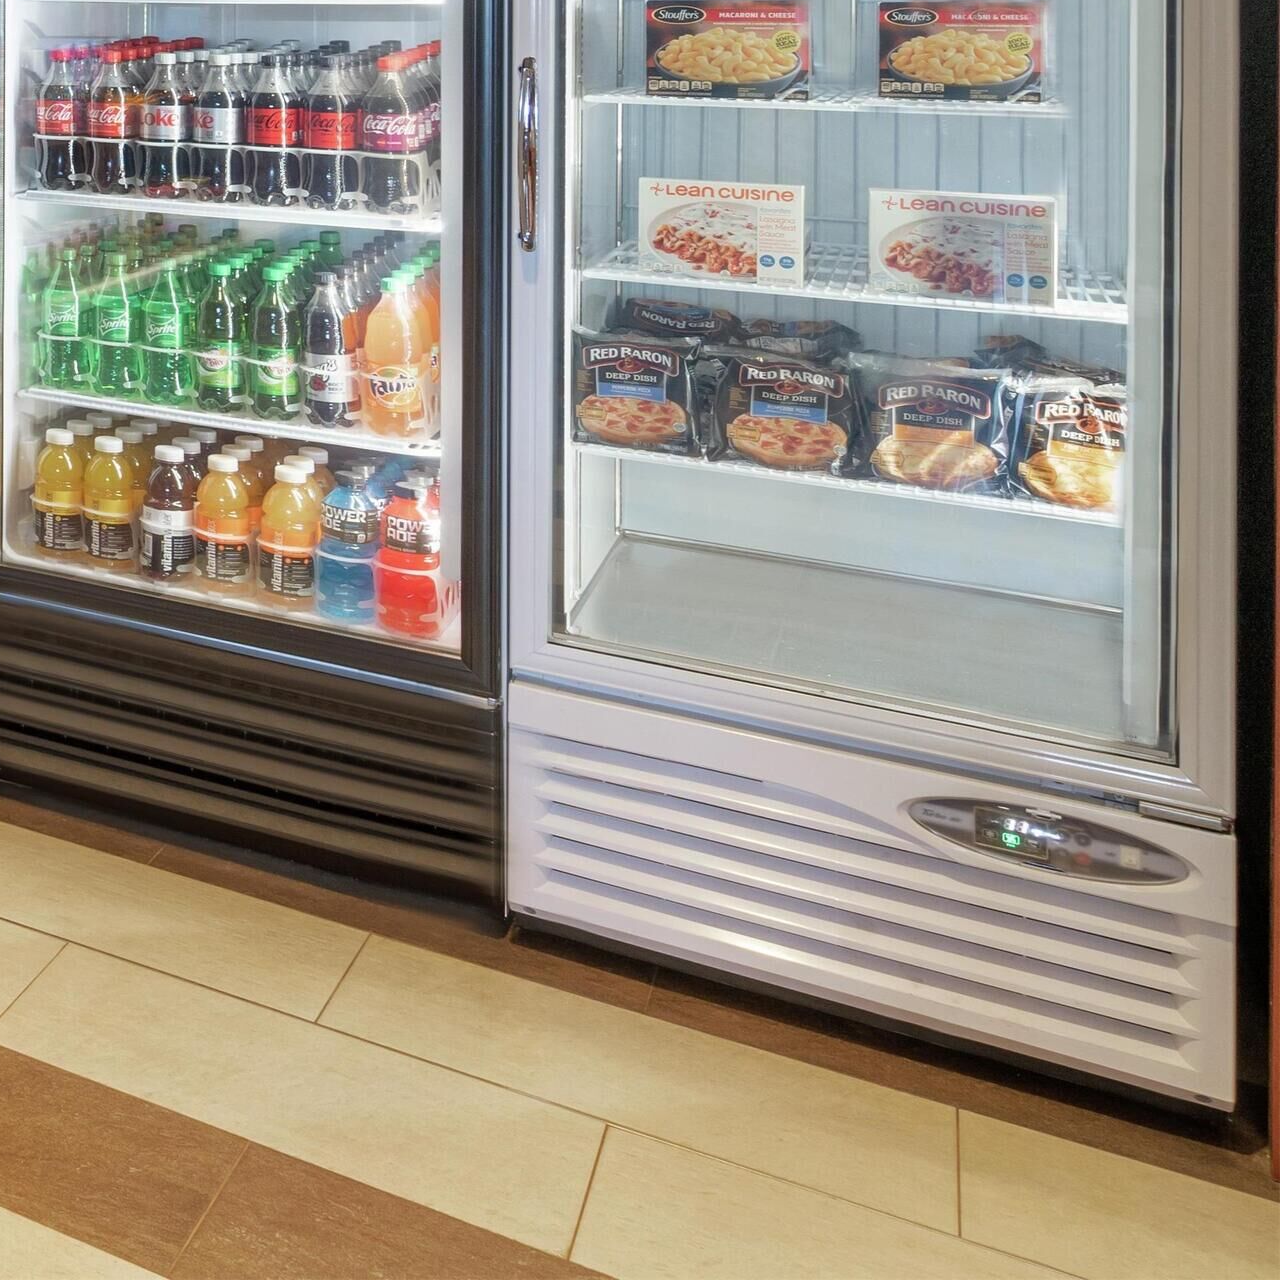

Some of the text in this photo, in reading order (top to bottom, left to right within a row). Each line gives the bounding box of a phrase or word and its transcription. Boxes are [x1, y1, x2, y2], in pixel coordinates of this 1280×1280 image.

[658, 8, 700, 21] Stouffer's
[890, 10, 933, 24] Stouffer's
[140, 108, 181, 128] oke
[363, 113, 416, 136] Coca-Cola
[665, 183, 715, 199] Lean
[899, 197, 956, 213] Lean
[590, 347, 673, 368] RED BARON
[605, 371, 658, 383] DEEP DISH
[747, 367, 836, 389] RED BARON
[761, 391, 818, 404] DEEP DISH
[886, 384, 982, 410] RED BARON
[902, 412, 964, 426] DEEP DISH
[1043, 403, 1081, 419] RED
[1060, 429, 1121, 448] DEEP DISH
[387, 528, 418, 543] ADE
